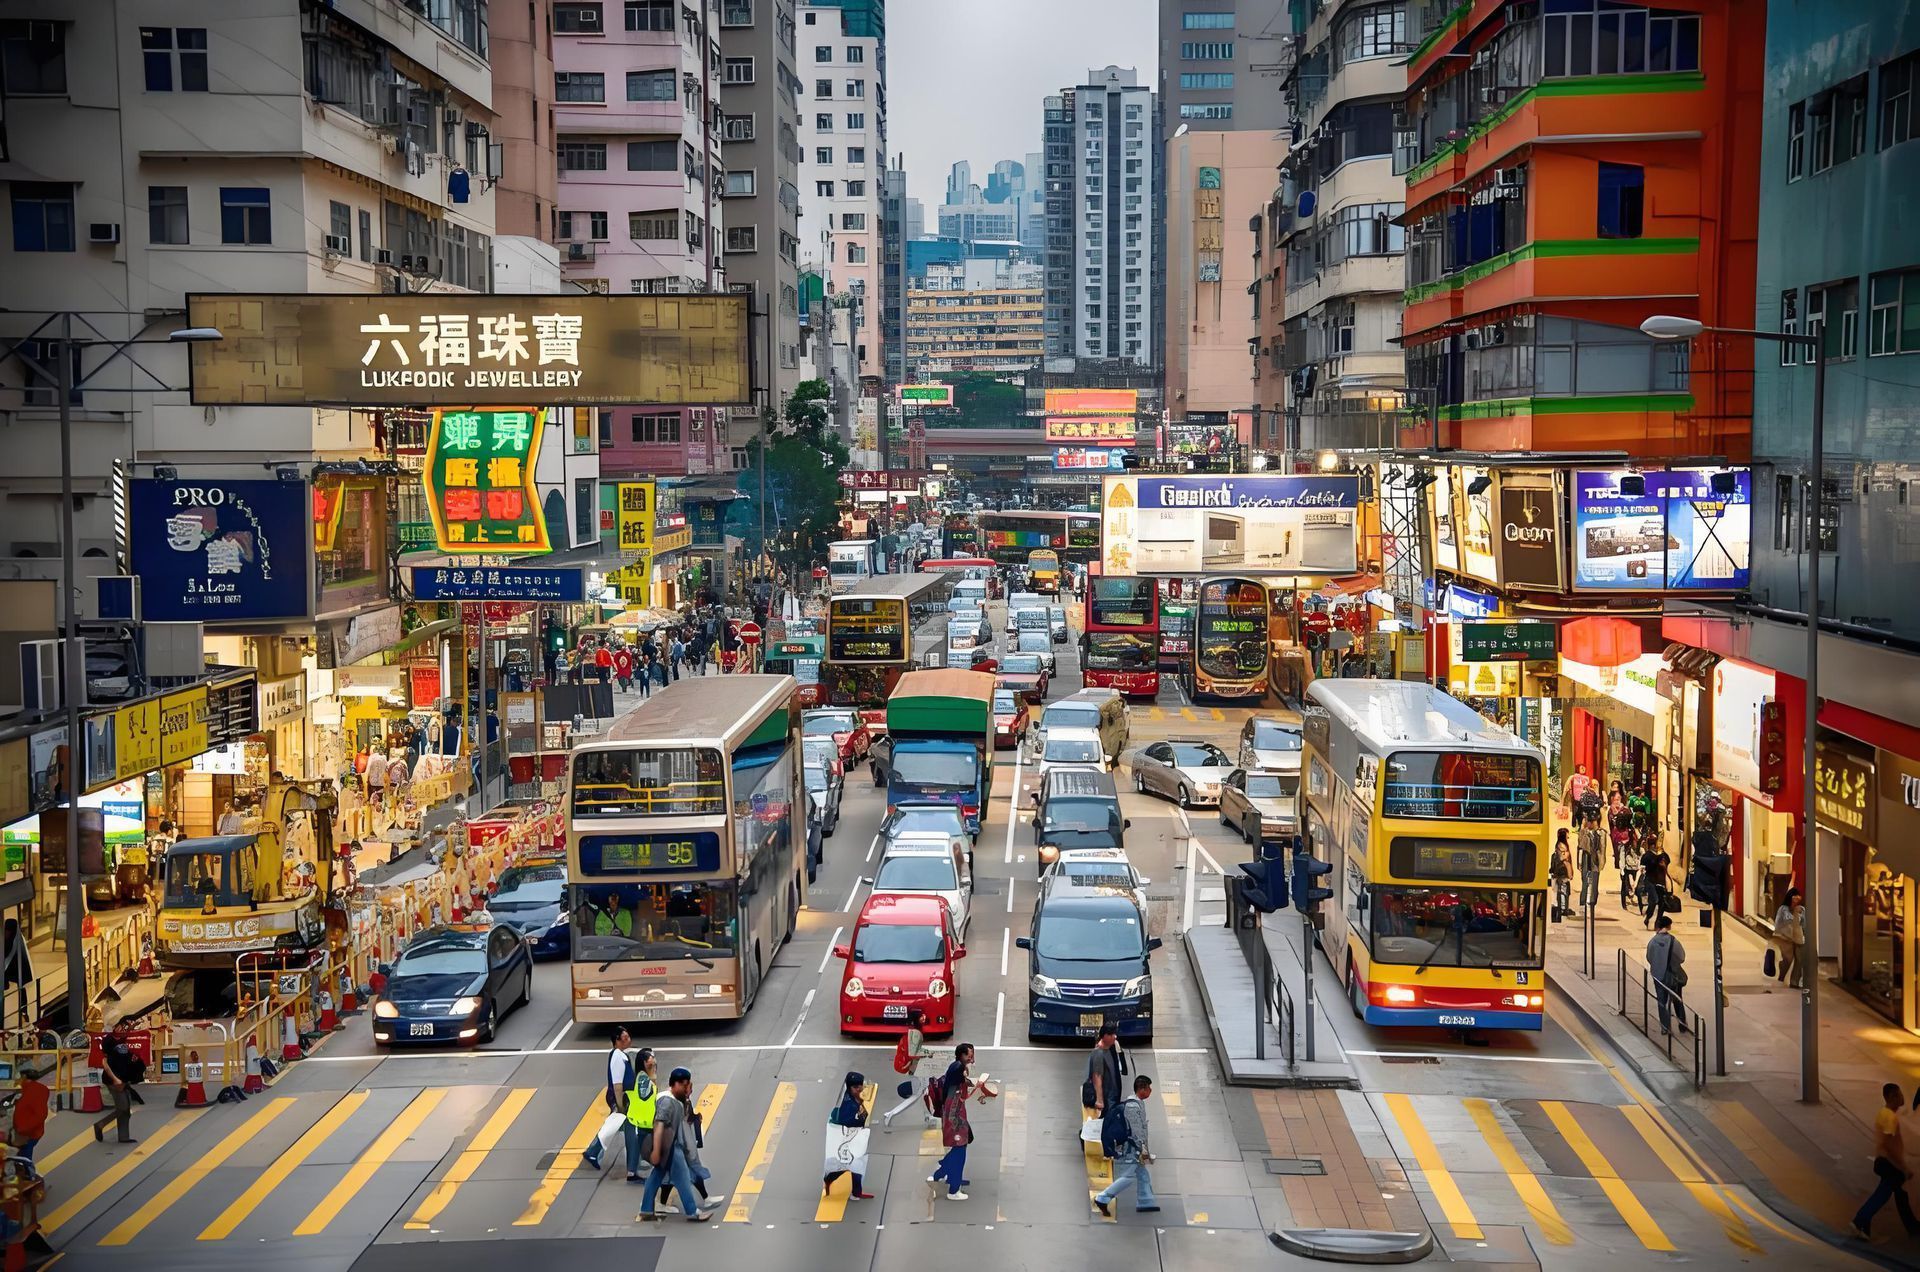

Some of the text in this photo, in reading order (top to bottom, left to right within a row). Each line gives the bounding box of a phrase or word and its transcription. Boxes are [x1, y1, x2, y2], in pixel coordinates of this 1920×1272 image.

[360, 313, 583, 366] 六福珠寶
[464, 369, 583, 388] JEWELLERY
